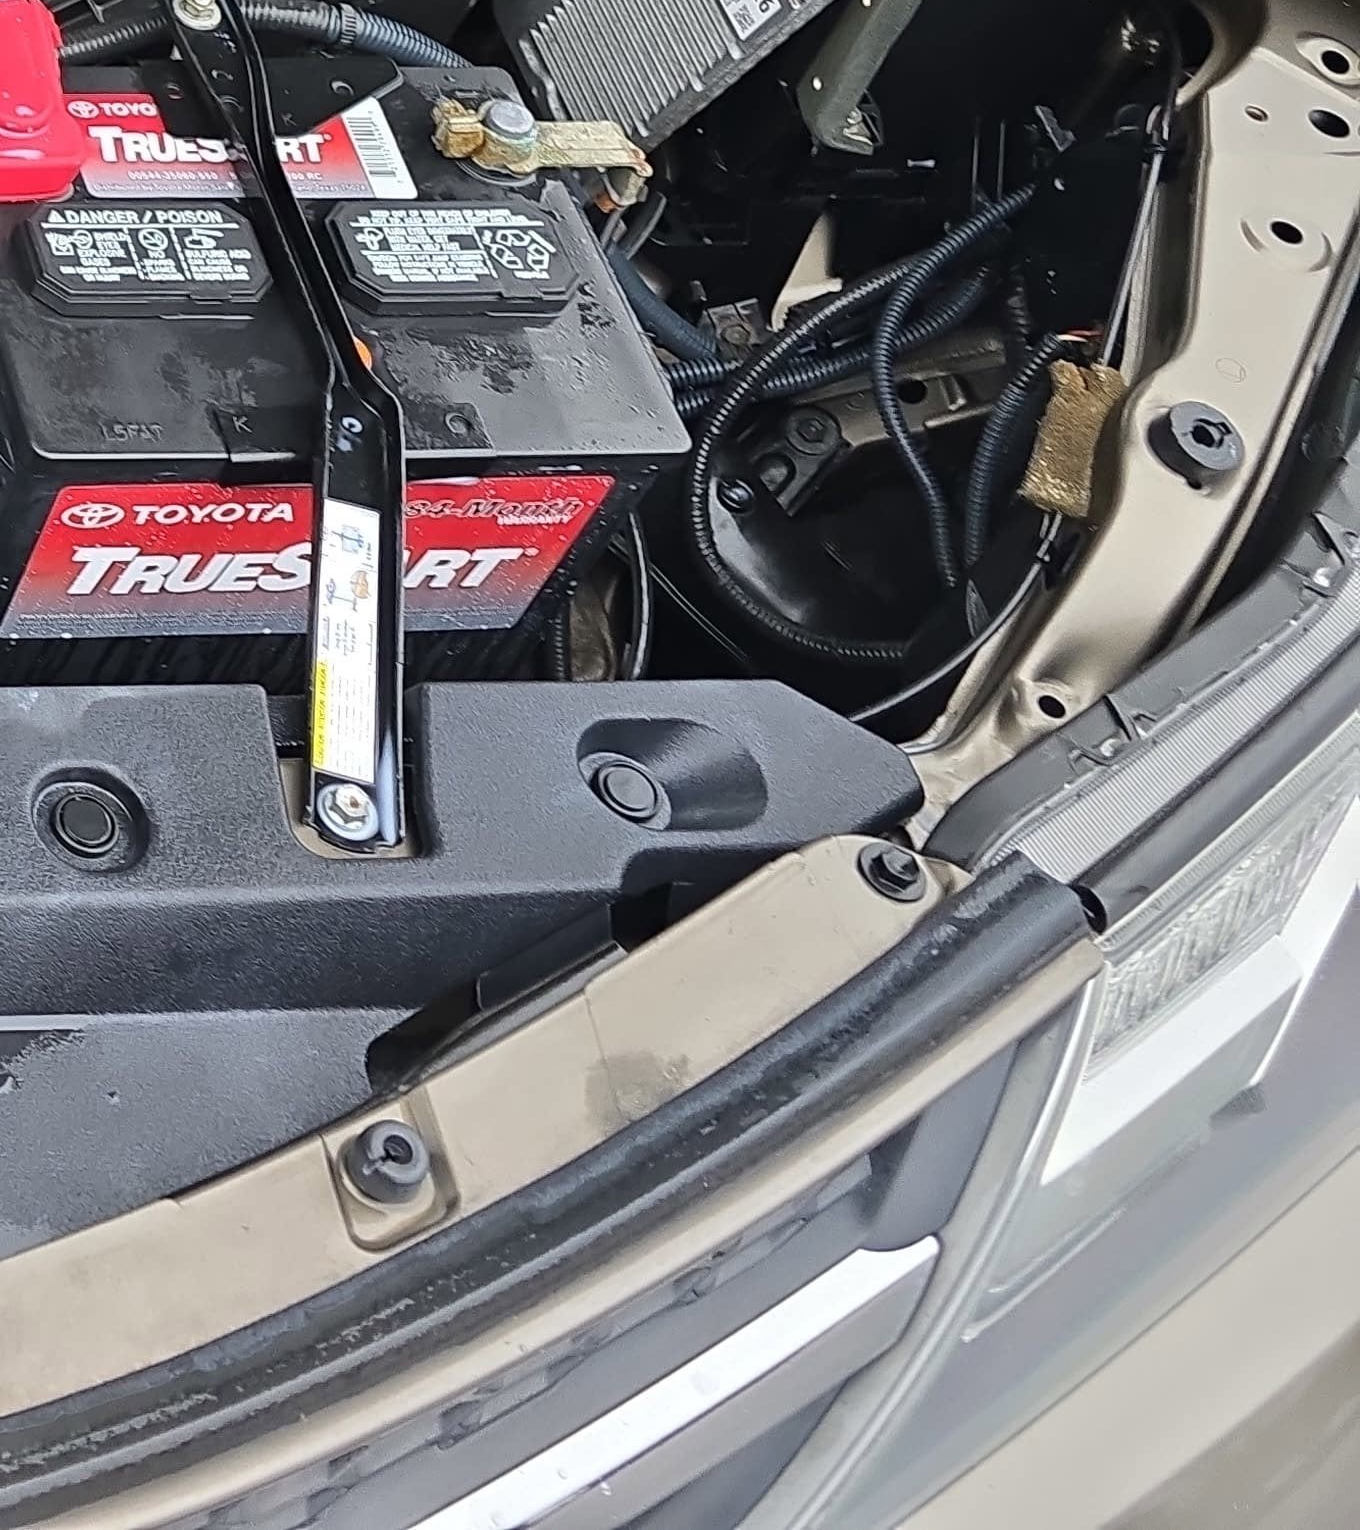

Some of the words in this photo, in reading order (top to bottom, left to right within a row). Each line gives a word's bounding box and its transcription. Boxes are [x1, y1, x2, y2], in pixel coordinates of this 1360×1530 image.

[100, 102, 158, 117] TOYO
[64, 210, 140, 223] DANGER
[155, 209, 223, 223] POISON
[132, 503, 294, 525] TOYOTA
